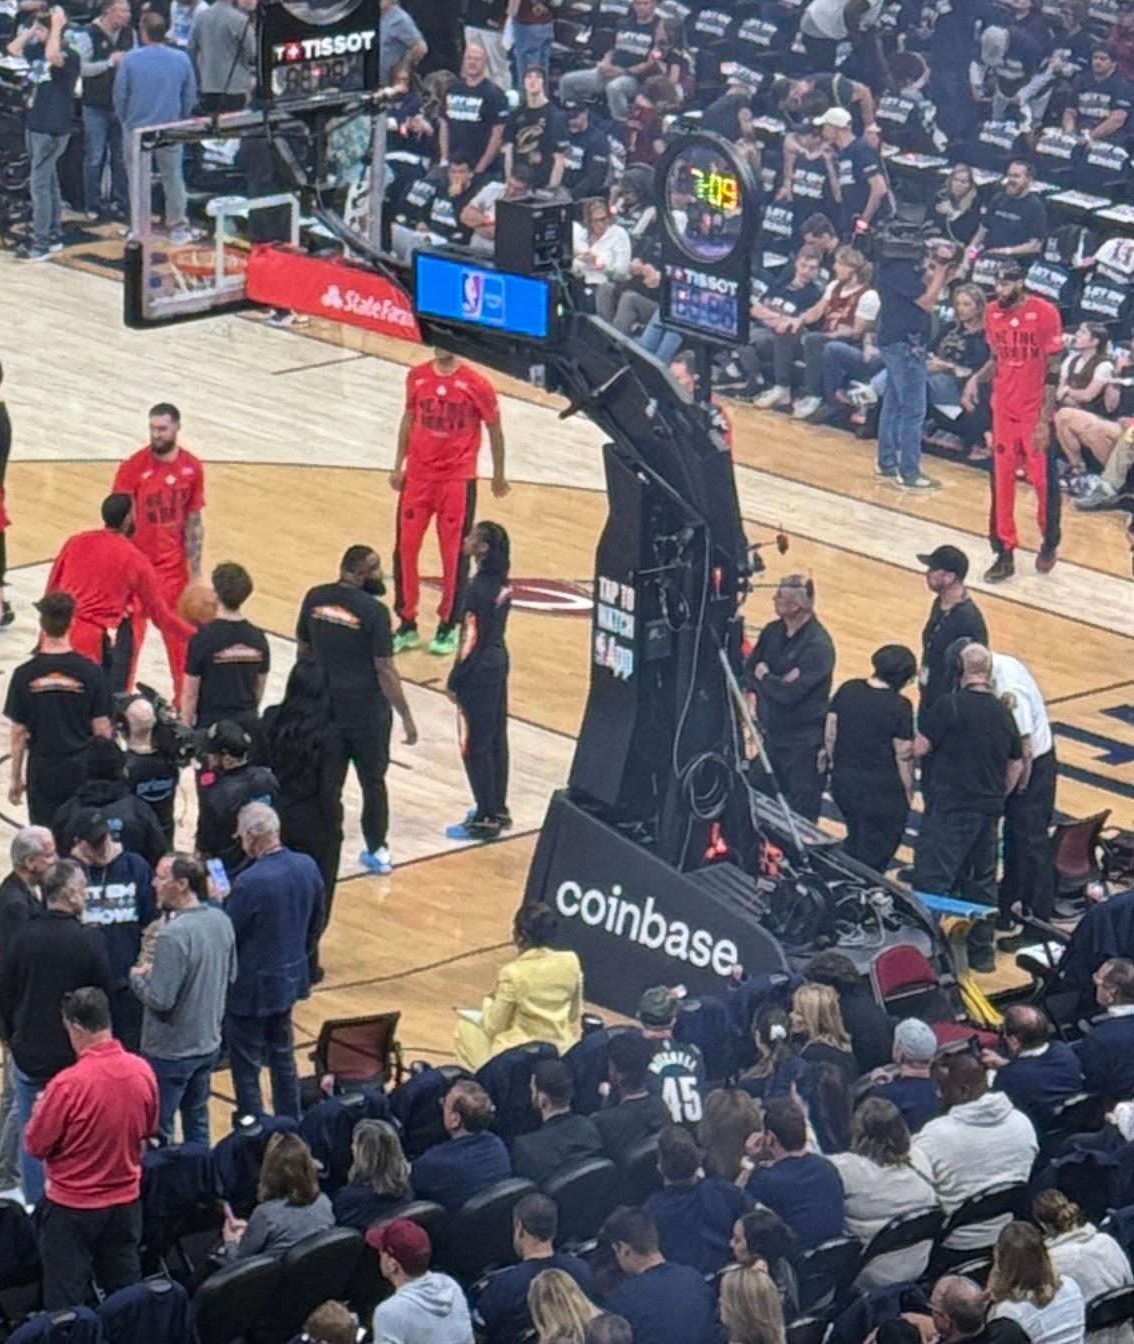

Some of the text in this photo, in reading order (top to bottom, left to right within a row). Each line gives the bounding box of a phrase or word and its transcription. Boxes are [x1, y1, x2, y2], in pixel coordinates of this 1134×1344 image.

[300, 30, 376, 60] TISSOT
[683, 268, 740, 297] TISSOT
[555, 880, 739, 976] coinbase
[661, 1075, 703, 1124] 45
